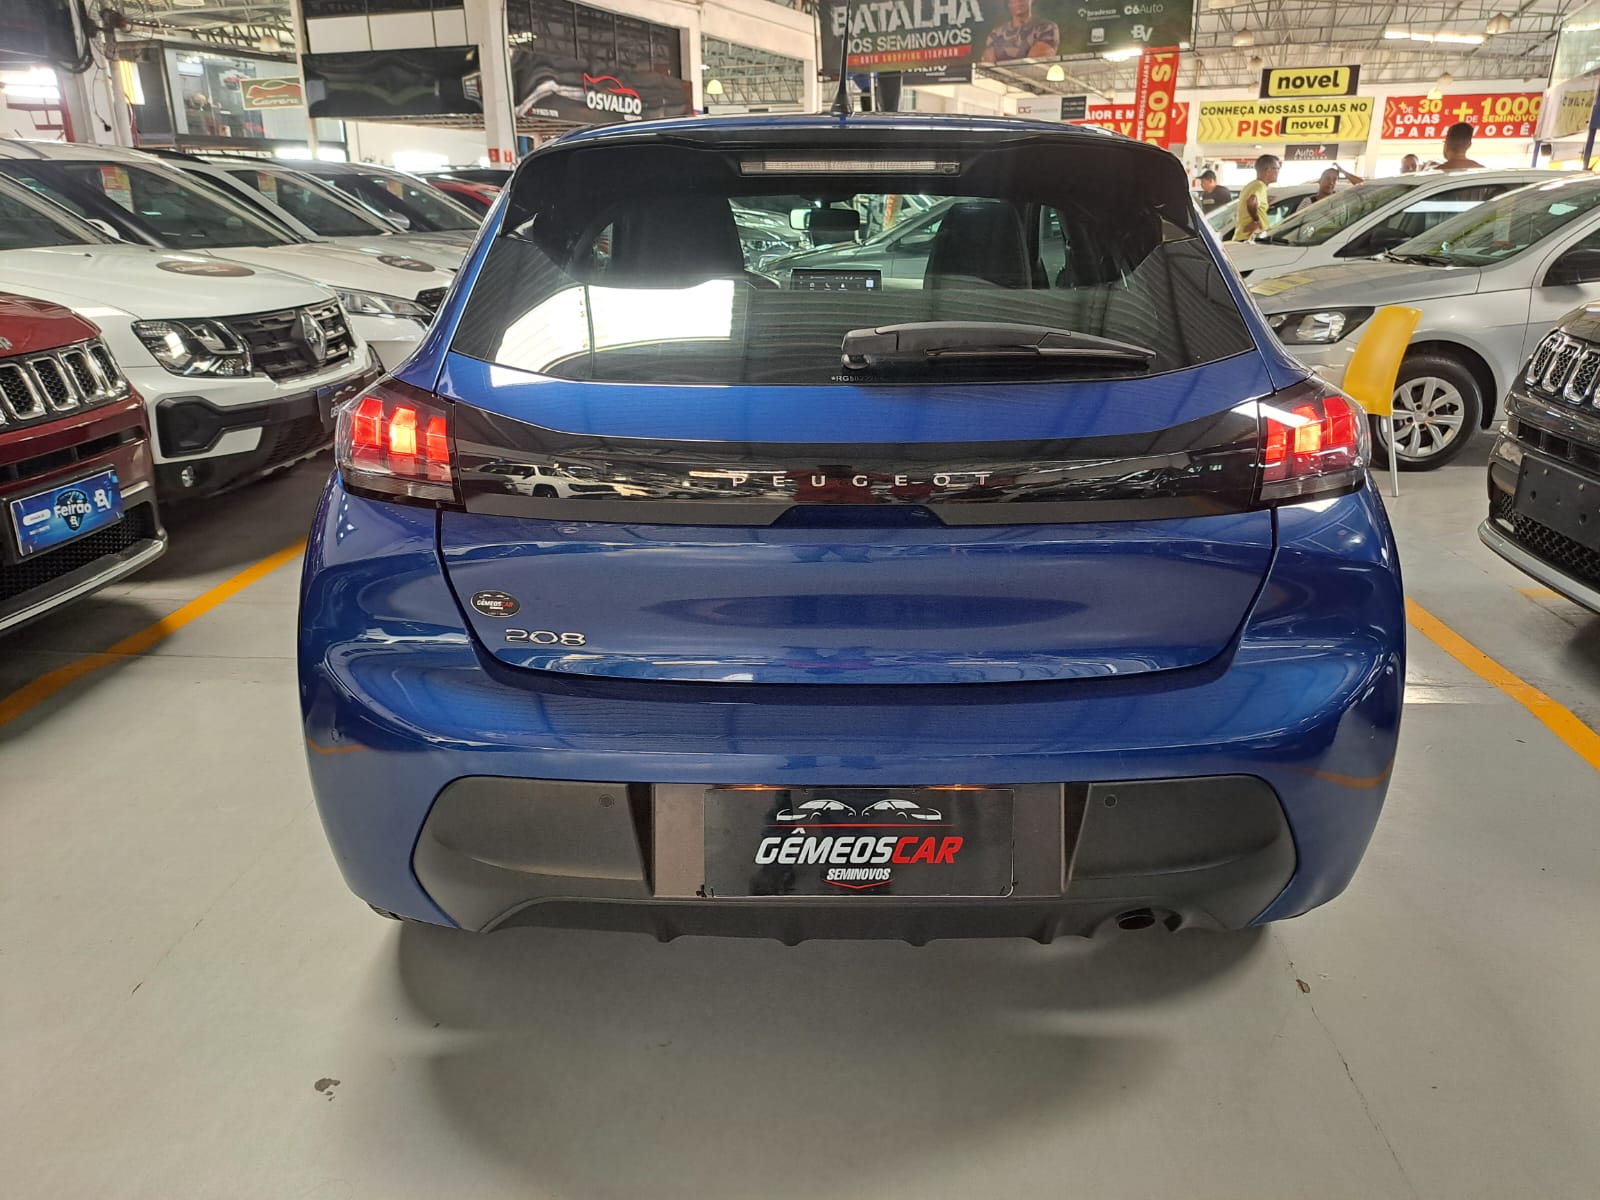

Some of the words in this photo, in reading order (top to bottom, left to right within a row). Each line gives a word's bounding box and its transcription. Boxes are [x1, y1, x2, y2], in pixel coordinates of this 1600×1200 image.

[831, 0, 984, 37] BATALHA
[877, 28, 972, 52] SEMINOVOS
[1277, 70, 1340, 90] novel
[586, 90, 642, 115] OSVALDO
[1200, 106, 1255, 117] CONHEÇA
[1258, 104, 1305, 115] NOSSAS
[1309, 103, 1346, 113] LOJAS
[1350, 102, 1368, 112] NO
[1418, 99, 1442, 113] 30
[1481, 96, 1543, 115] 1000
[1085, 110, 1112, 121] AIOR
[1291, 118, 1329, 129] novel
[1396, 114, 1440, 124] LOJAS
[1237, 119, 1282, 137] PIS
[732, 473, 994, 488] PEUGEOT
[53, 500, 92, 518] Feirão
[505, 628, 586, 647] 208
[826, 868, 891, 881] SEMINOVOS
